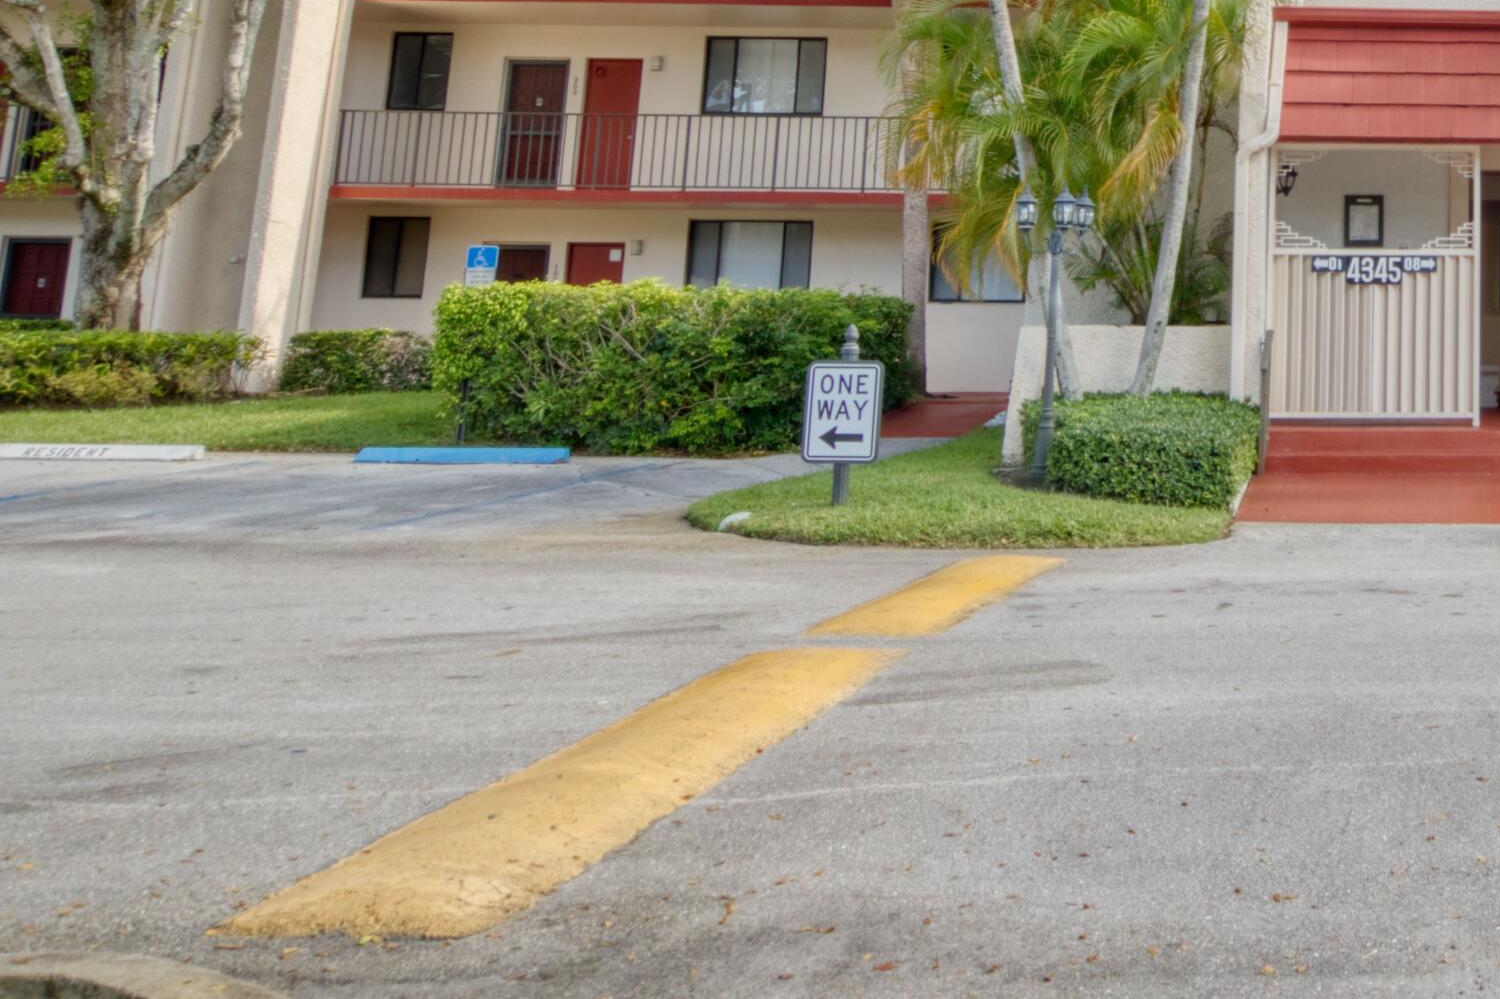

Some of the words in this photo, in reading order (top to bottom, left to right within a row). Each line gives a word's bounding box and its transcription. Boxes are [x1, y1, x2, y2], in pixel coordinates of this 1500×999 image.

[1346, 256, 1402, 283] 4345
[1404, 257, 1421, 271] 08
[820, 374, 869, 394] ONE
[817, 399, 868, 420] WAY
[22, 447, 110, 457] RESIDENT
